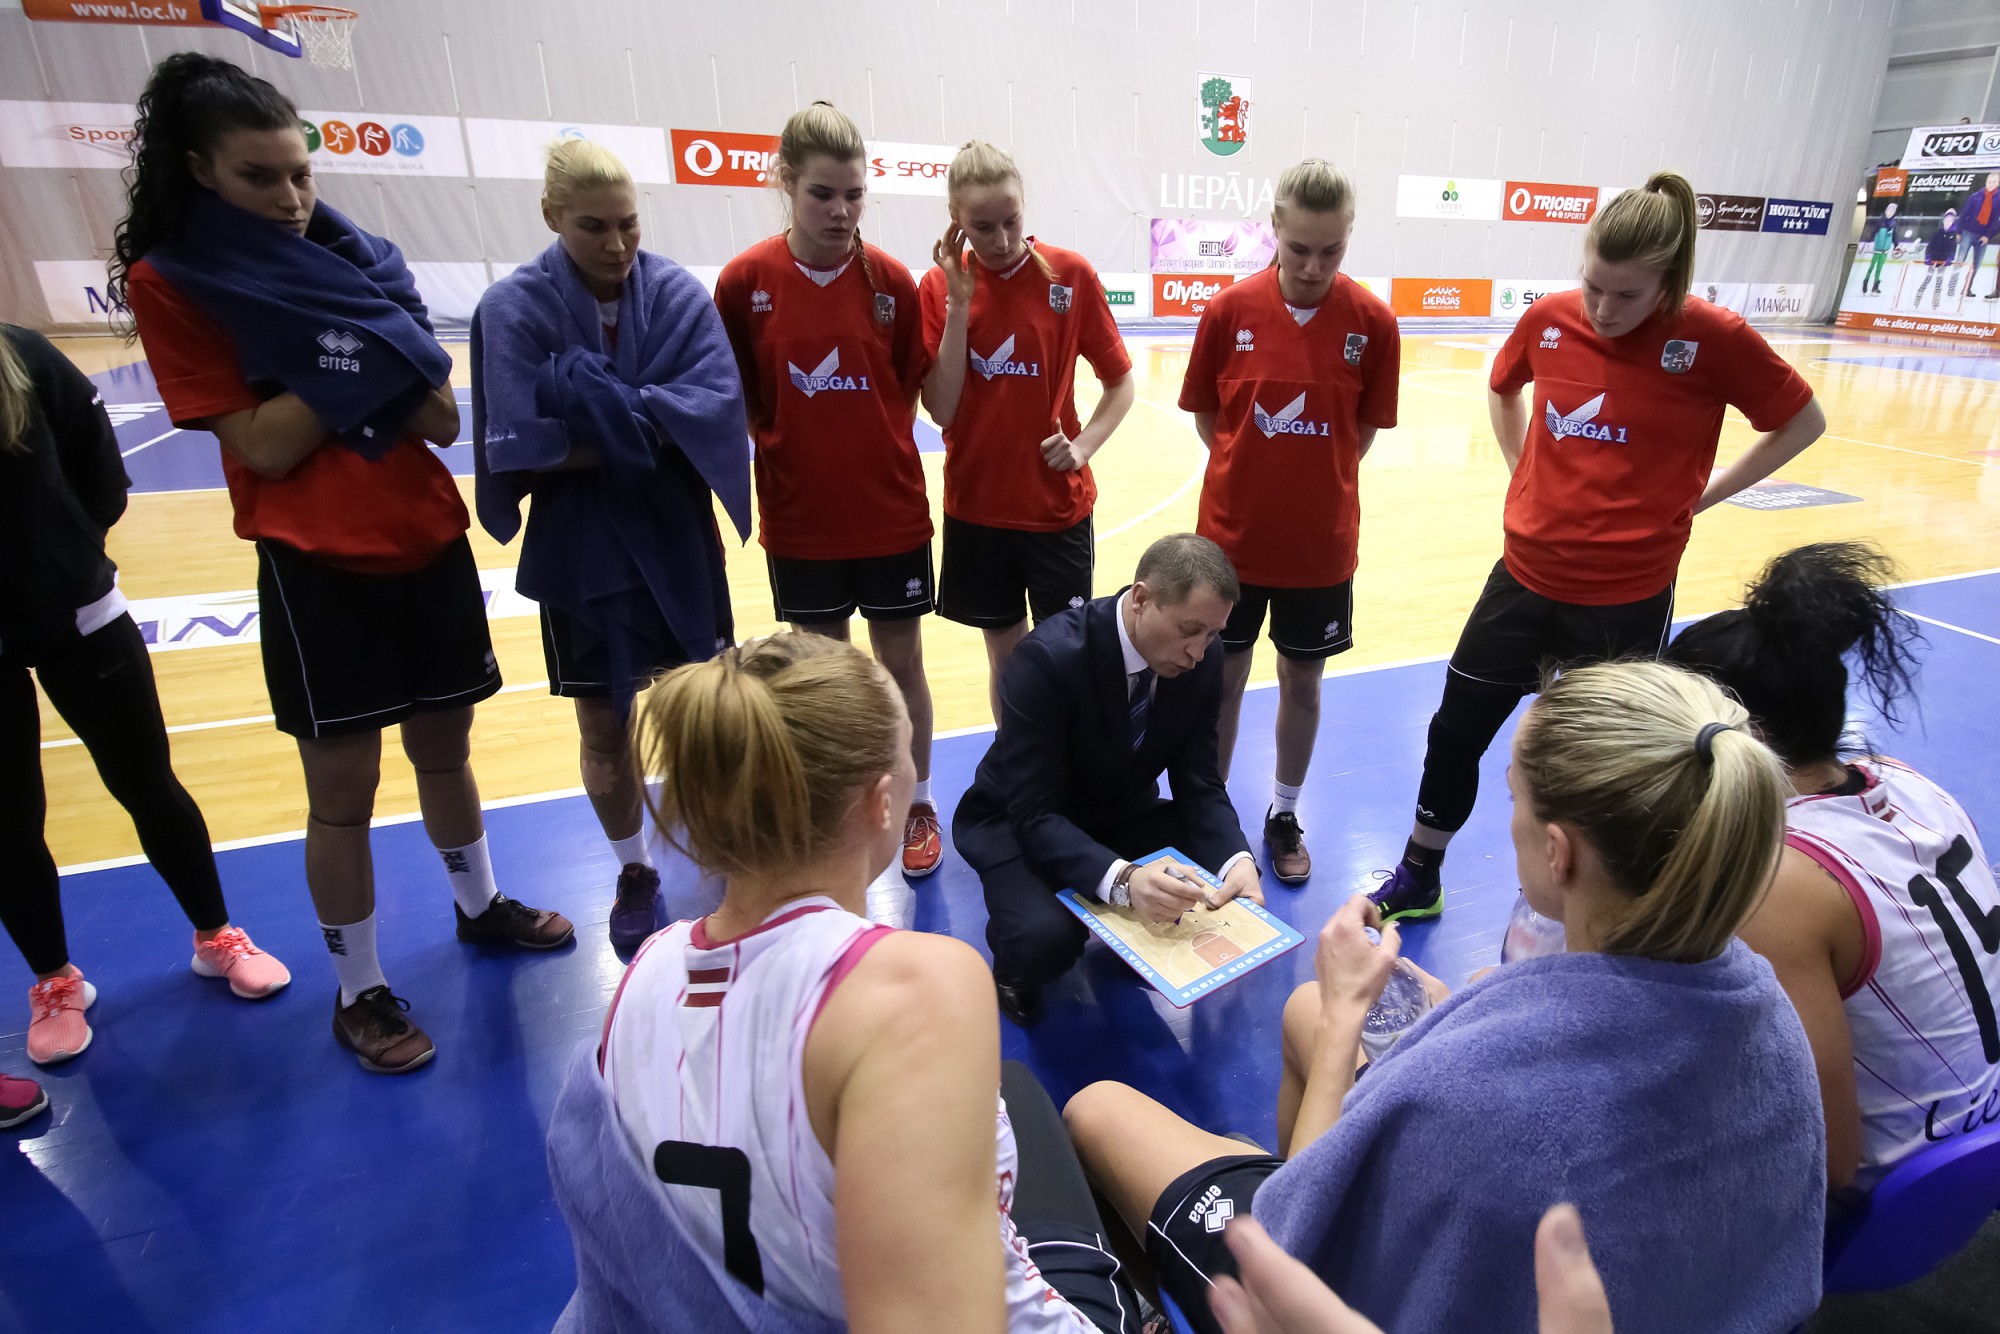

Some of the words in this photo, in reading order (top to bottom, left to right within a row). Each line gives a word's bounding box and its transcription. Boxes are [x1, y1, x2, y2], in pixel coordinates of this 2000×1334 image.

[71, 1, 188, 20] www.loc.lv
[1160, 171, 1276, 218] LIEPĀJA
[1533, 195, 1591, 212] TRIOBET
[1563, 212, 1587, 221] SPORTS
[1768, 204, 1800, 217] HOTEL
[752, 303, 773, 313] errea
[1422, 295, 1461, 305] LIEPĀJAS
[1754, 298, 1801, 312] MANGALI
[1873, 317, 1891, 327] Nāc
[1891, 318, 1915, 330] slīdot
[1929, 323, 1958, 334] spēlēt
[1958, 325, 1997, 338] hokeju!
[1235, 343, 1254, 351] errea
[1539, 340, 1559, 349] errea
[319, 355, 360, 373] errea
[981, 361, 1028, 376] VEGA
[1030, 363, 1040, 377] 1
[801, 376, 857, 391] VEGA
[859, 376, 870, 391] 1
[1264, 418, 1317, 435] VEGA
[1319, 422, 1330, 436] 1
[1555, 418, 1612, 441] VEGA
[1615, 427, 1628, 443] 1
[1228, 937, 1291, 973] ARMANDS
[1128, 954, 1154, 979] VEGA
[1182, 973, 1226, 999] MISUS
[1188, 1184, 1222, 1224] errea
[654, 1140, 765, 1299] 7
